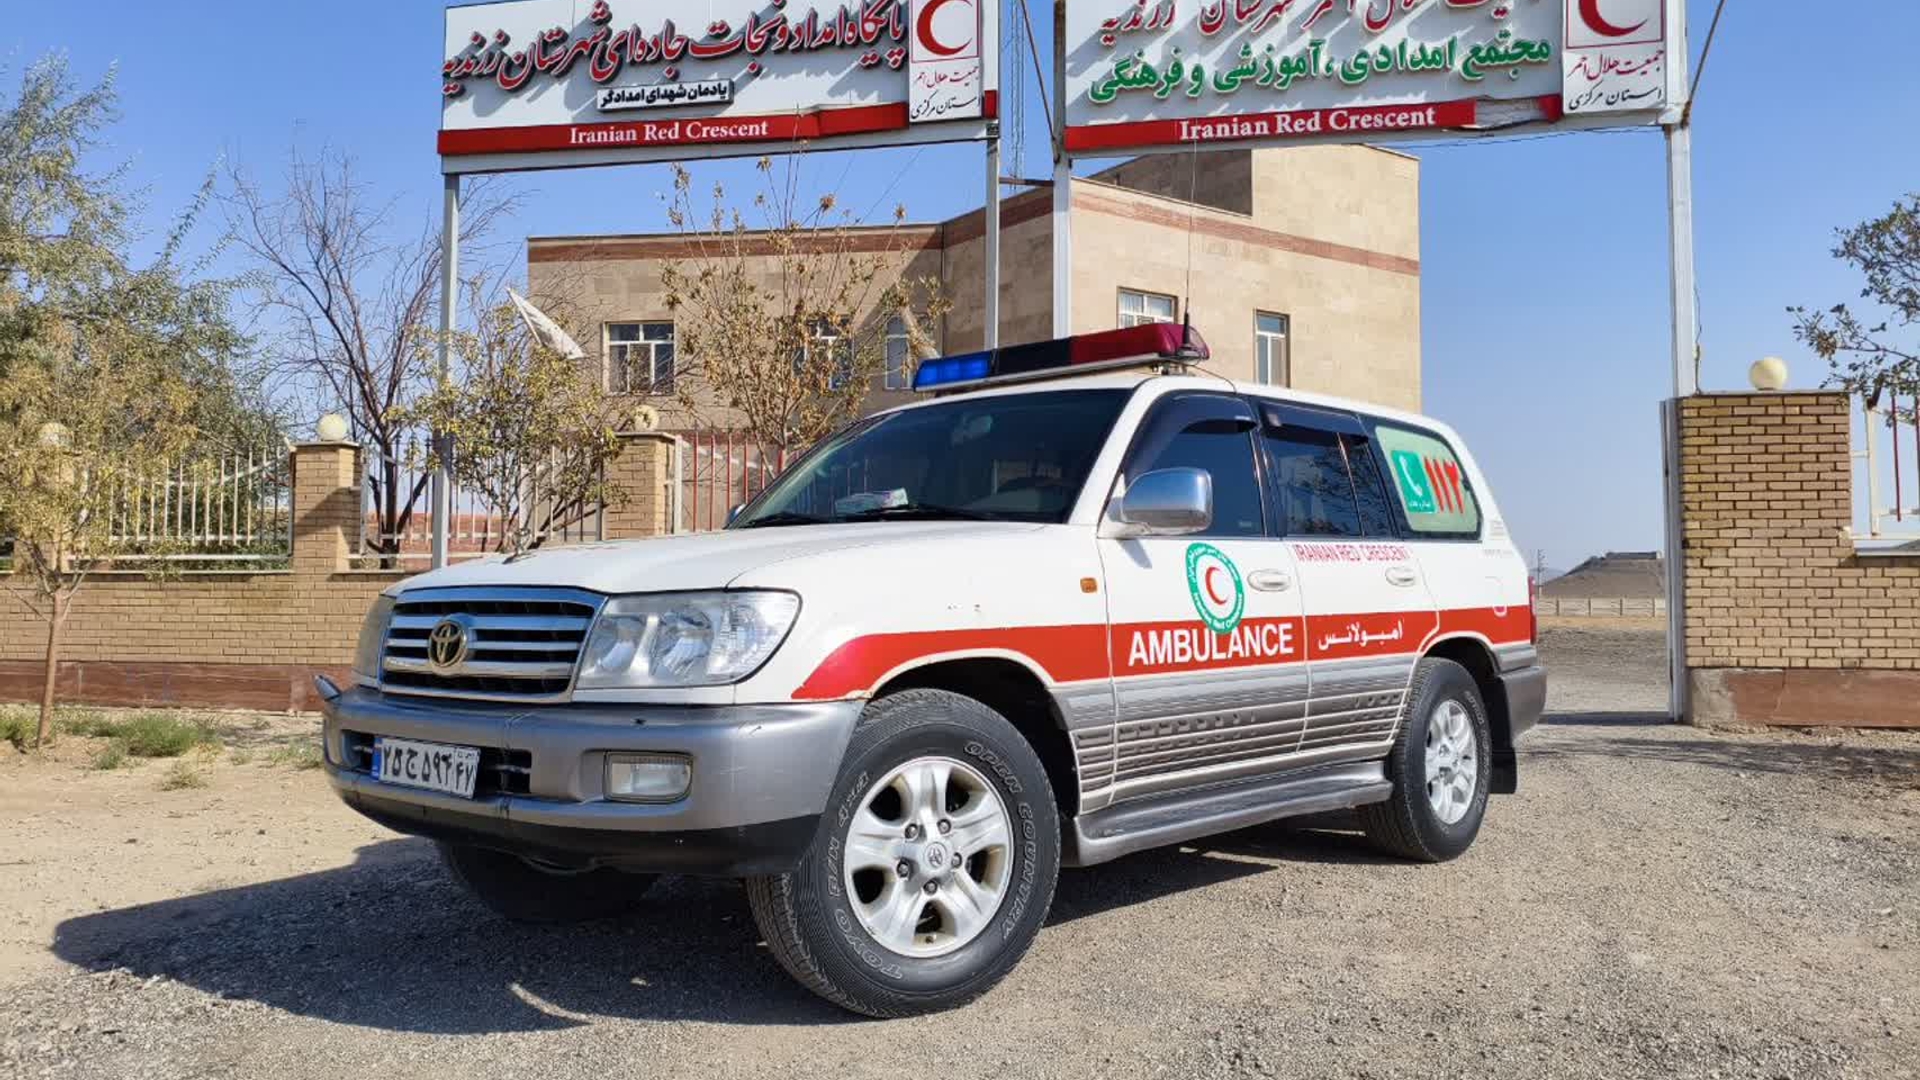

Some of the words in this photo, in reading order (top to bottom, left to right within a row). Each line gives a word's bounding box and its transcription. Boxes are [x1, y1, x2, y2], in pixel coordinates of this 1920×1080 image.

[688, 0, 784, 74] نجات
[770, 23, 789, 51] و
[788, 4, 847, 50] امداد
[844, 0, 906, 69] پایگاه
[441, 28, 505, 95] زرندیه
[496, 0, 607, 90] شهرستان
[1461, 28, 1551, 81] مجتمع
[1615, 49, 1664, 75] جمعیت
[1088, 46, 1185, 103] فرهنگی
[1186, 60, 1206, 97] و
[1213, 38, 1327, 92] آموزشی
[1567, 56, 1588, 78] احمر
[1586, 54, 1620, 80] هلال
[600, 88, 646, 108] امدادگر
[646, 83, 687, 105] شهدای
[687, 82, 728, 101] یادمان
[910, 89, 939, 119] مرکزی
[1568, 79, 1604, 111] مرکزی
[1605, 86, 1662, 105] استان
[569, 126, 637, 145] Iranian
[643, 121, 680, 141] Red
[685, 120, 769, 139] Crescent
[1179, 117, 1269, 141] Iranian
[1276, 111, 1323, 134] Red
[1328, 107, 1436, 131] Crescent
[1128, 622, 1294, 667] AMBULANCE
[964, 741, 1023, 793] OPEN
[1001, 802, 1037, 940] COUNTRY
